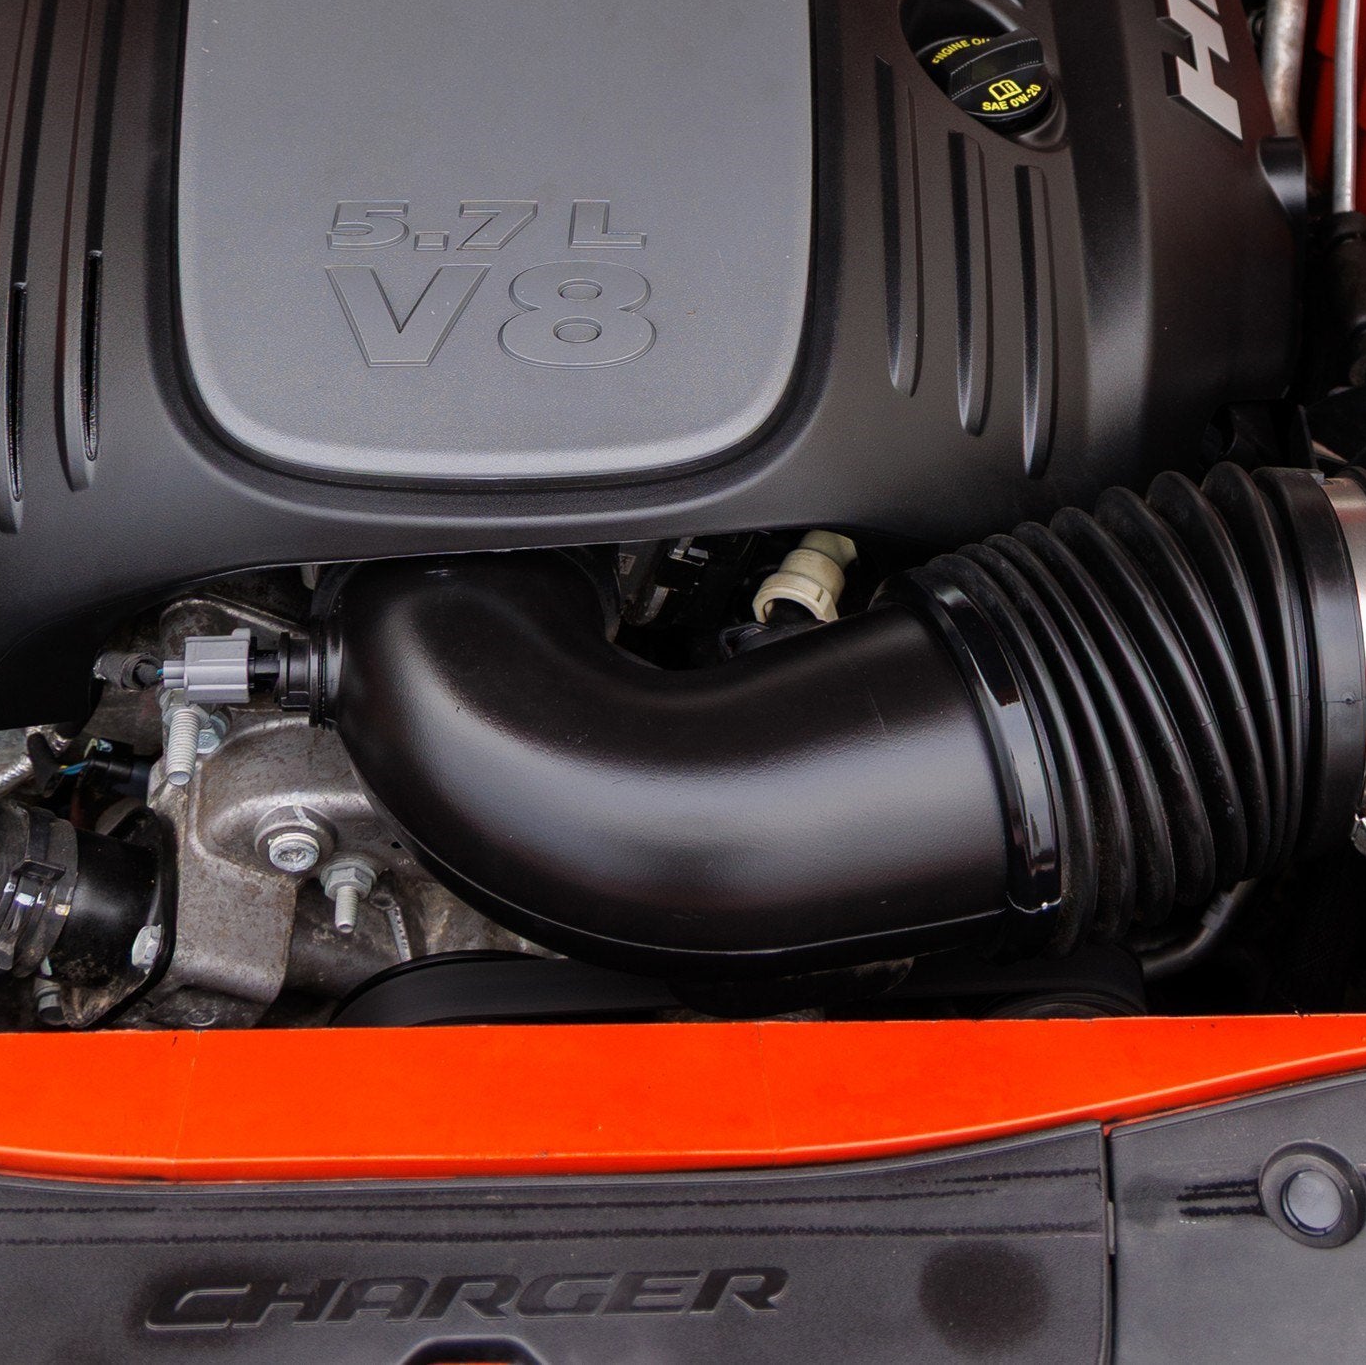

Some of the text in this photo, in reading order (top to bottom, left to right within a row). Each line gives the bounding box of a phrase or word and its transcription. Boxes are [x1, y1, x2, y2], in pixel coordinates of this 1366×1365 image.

[932, 40, 970, 64] ENGINE
[982, 84, 1041, 111] SAE 0W-20
[325, 260, 657, 370] V8
[144, 1266, 789, 1330] CHARGER
